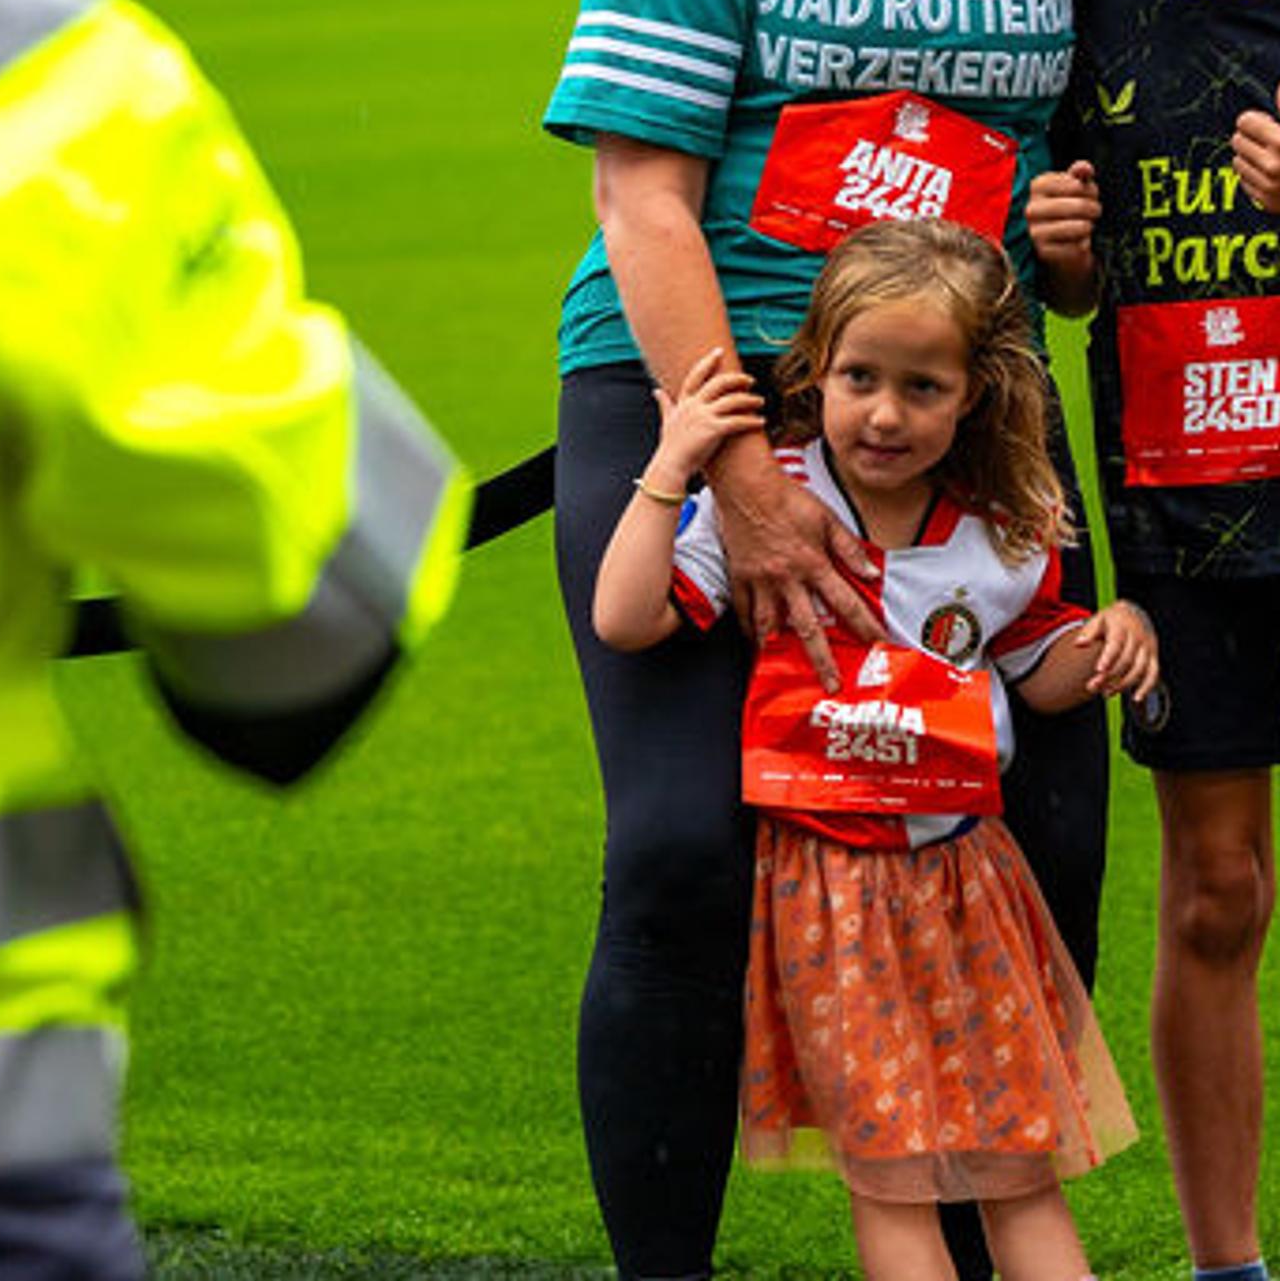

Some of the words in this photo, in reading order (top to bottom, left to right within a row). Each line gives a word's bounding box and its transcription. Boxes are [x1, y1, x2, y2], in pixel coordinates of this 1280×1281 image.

[838, 137, 954, 204] ANITA
[1137, 156, 1265, 219] Eur
[1182, 357, 1279, 399] STEN
[824, 727, 919, 765] 2451
